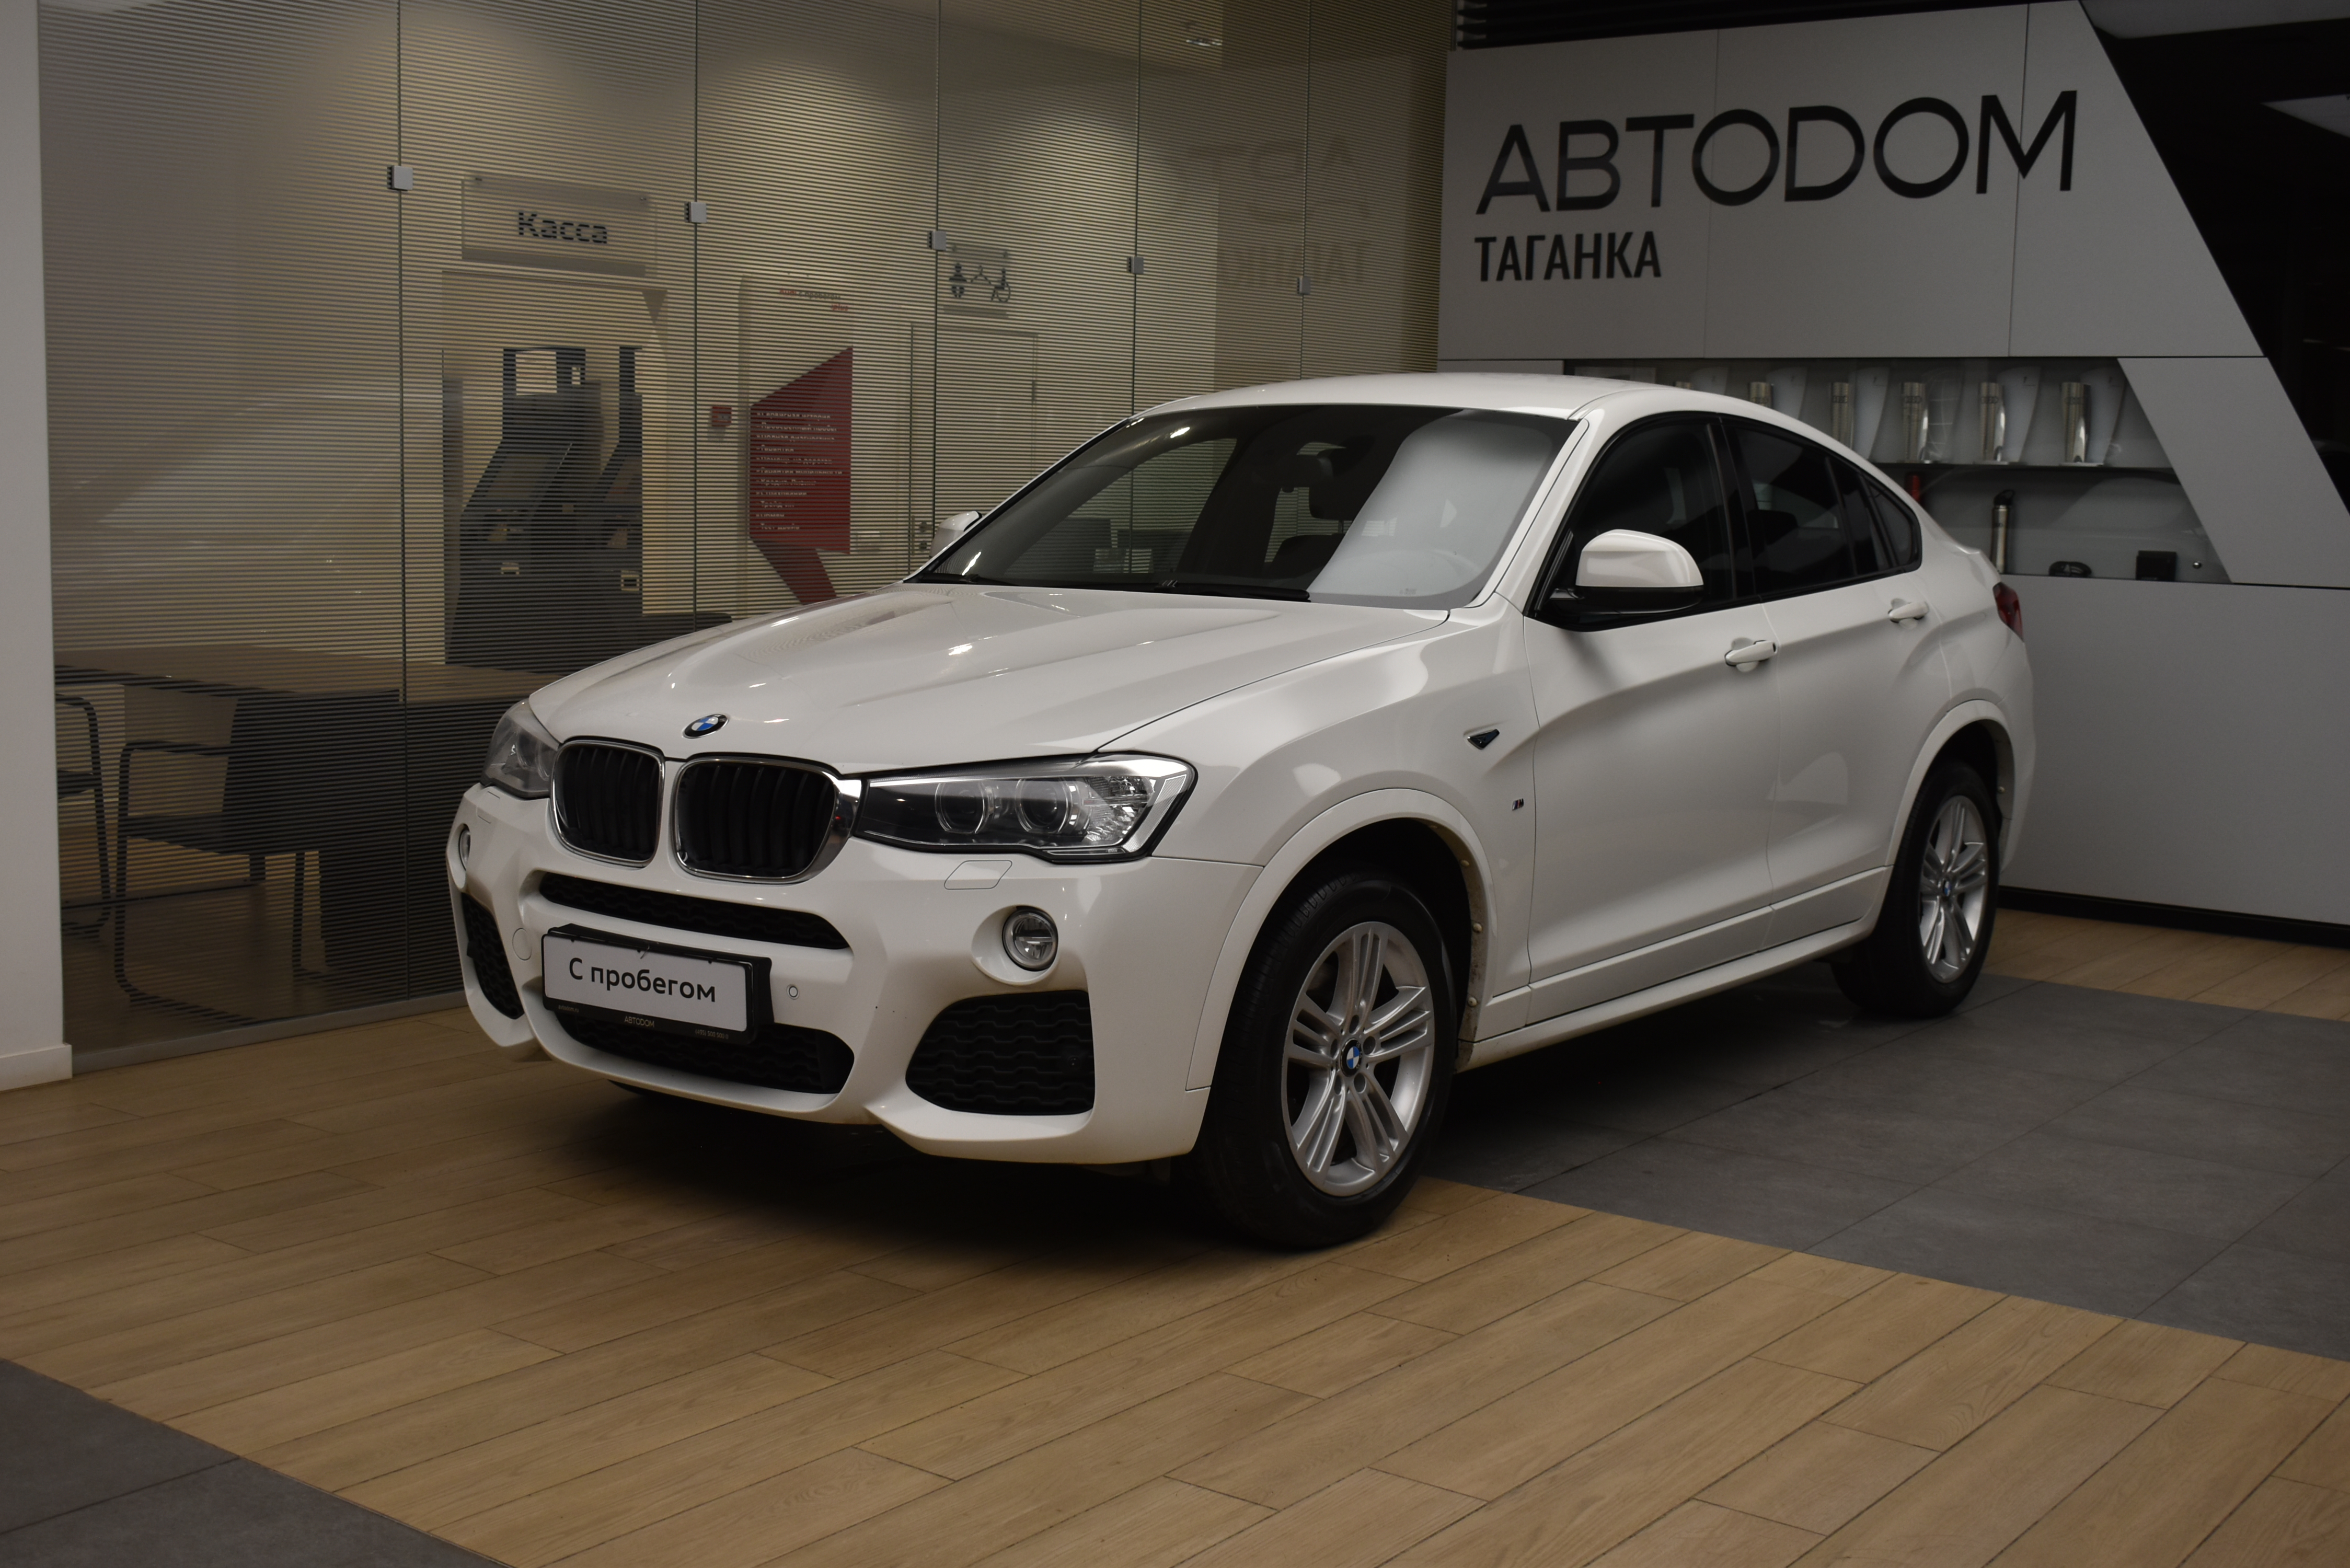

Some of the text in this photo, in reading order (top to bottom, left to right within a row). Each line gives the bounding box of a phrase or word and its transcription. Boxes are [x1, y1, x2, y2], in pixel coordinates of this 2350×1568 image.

[519, 212, 607, 244] Касса
[1474, 231, 1662, 282] ТАГАНКА
[569, 958, 716, 1002] С пробегом
